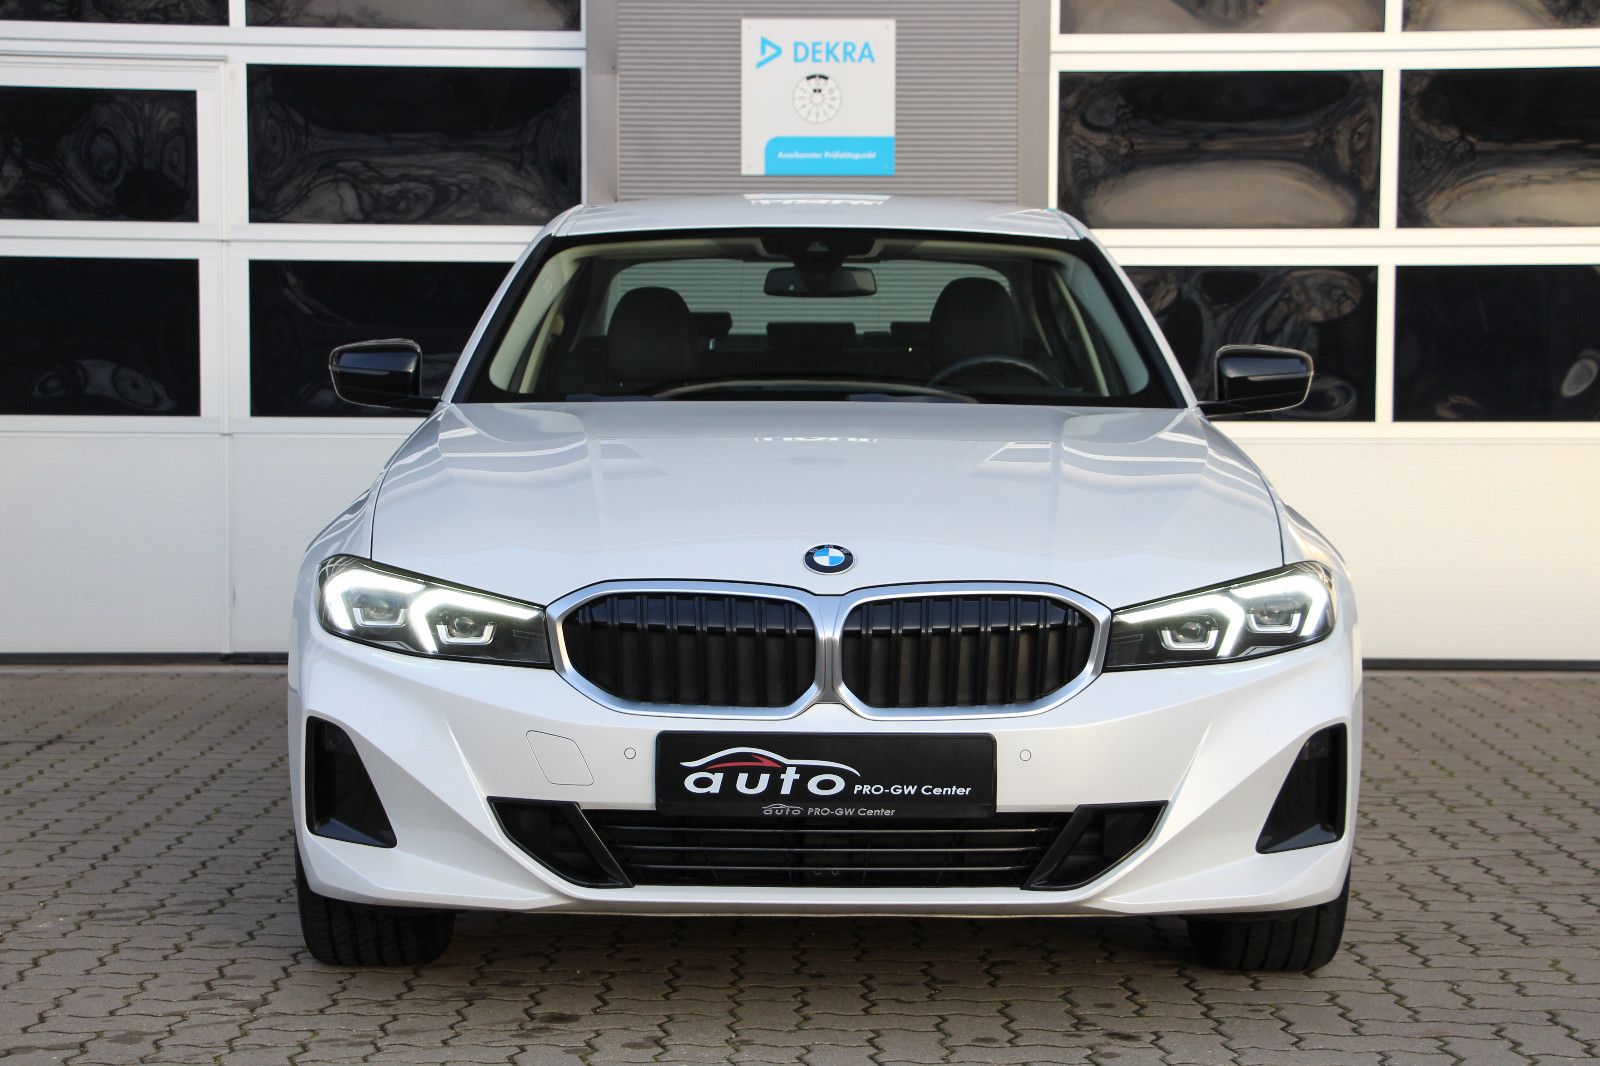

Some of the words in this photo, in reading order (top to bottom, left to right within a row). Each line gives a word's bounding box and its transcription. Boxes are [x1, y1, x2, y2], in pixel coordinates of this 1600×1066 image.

[793, 41, 876, 63] DEKRA
[683, 766, 846, 796] auto
[853, 784, 919, 796] PRO-GW
[921, 784, 972, 797] Center
[763, 807, 801, 816] auto
[807, 807, 855, 816] PRO-GW
[857, 807, 896, 817] Center
